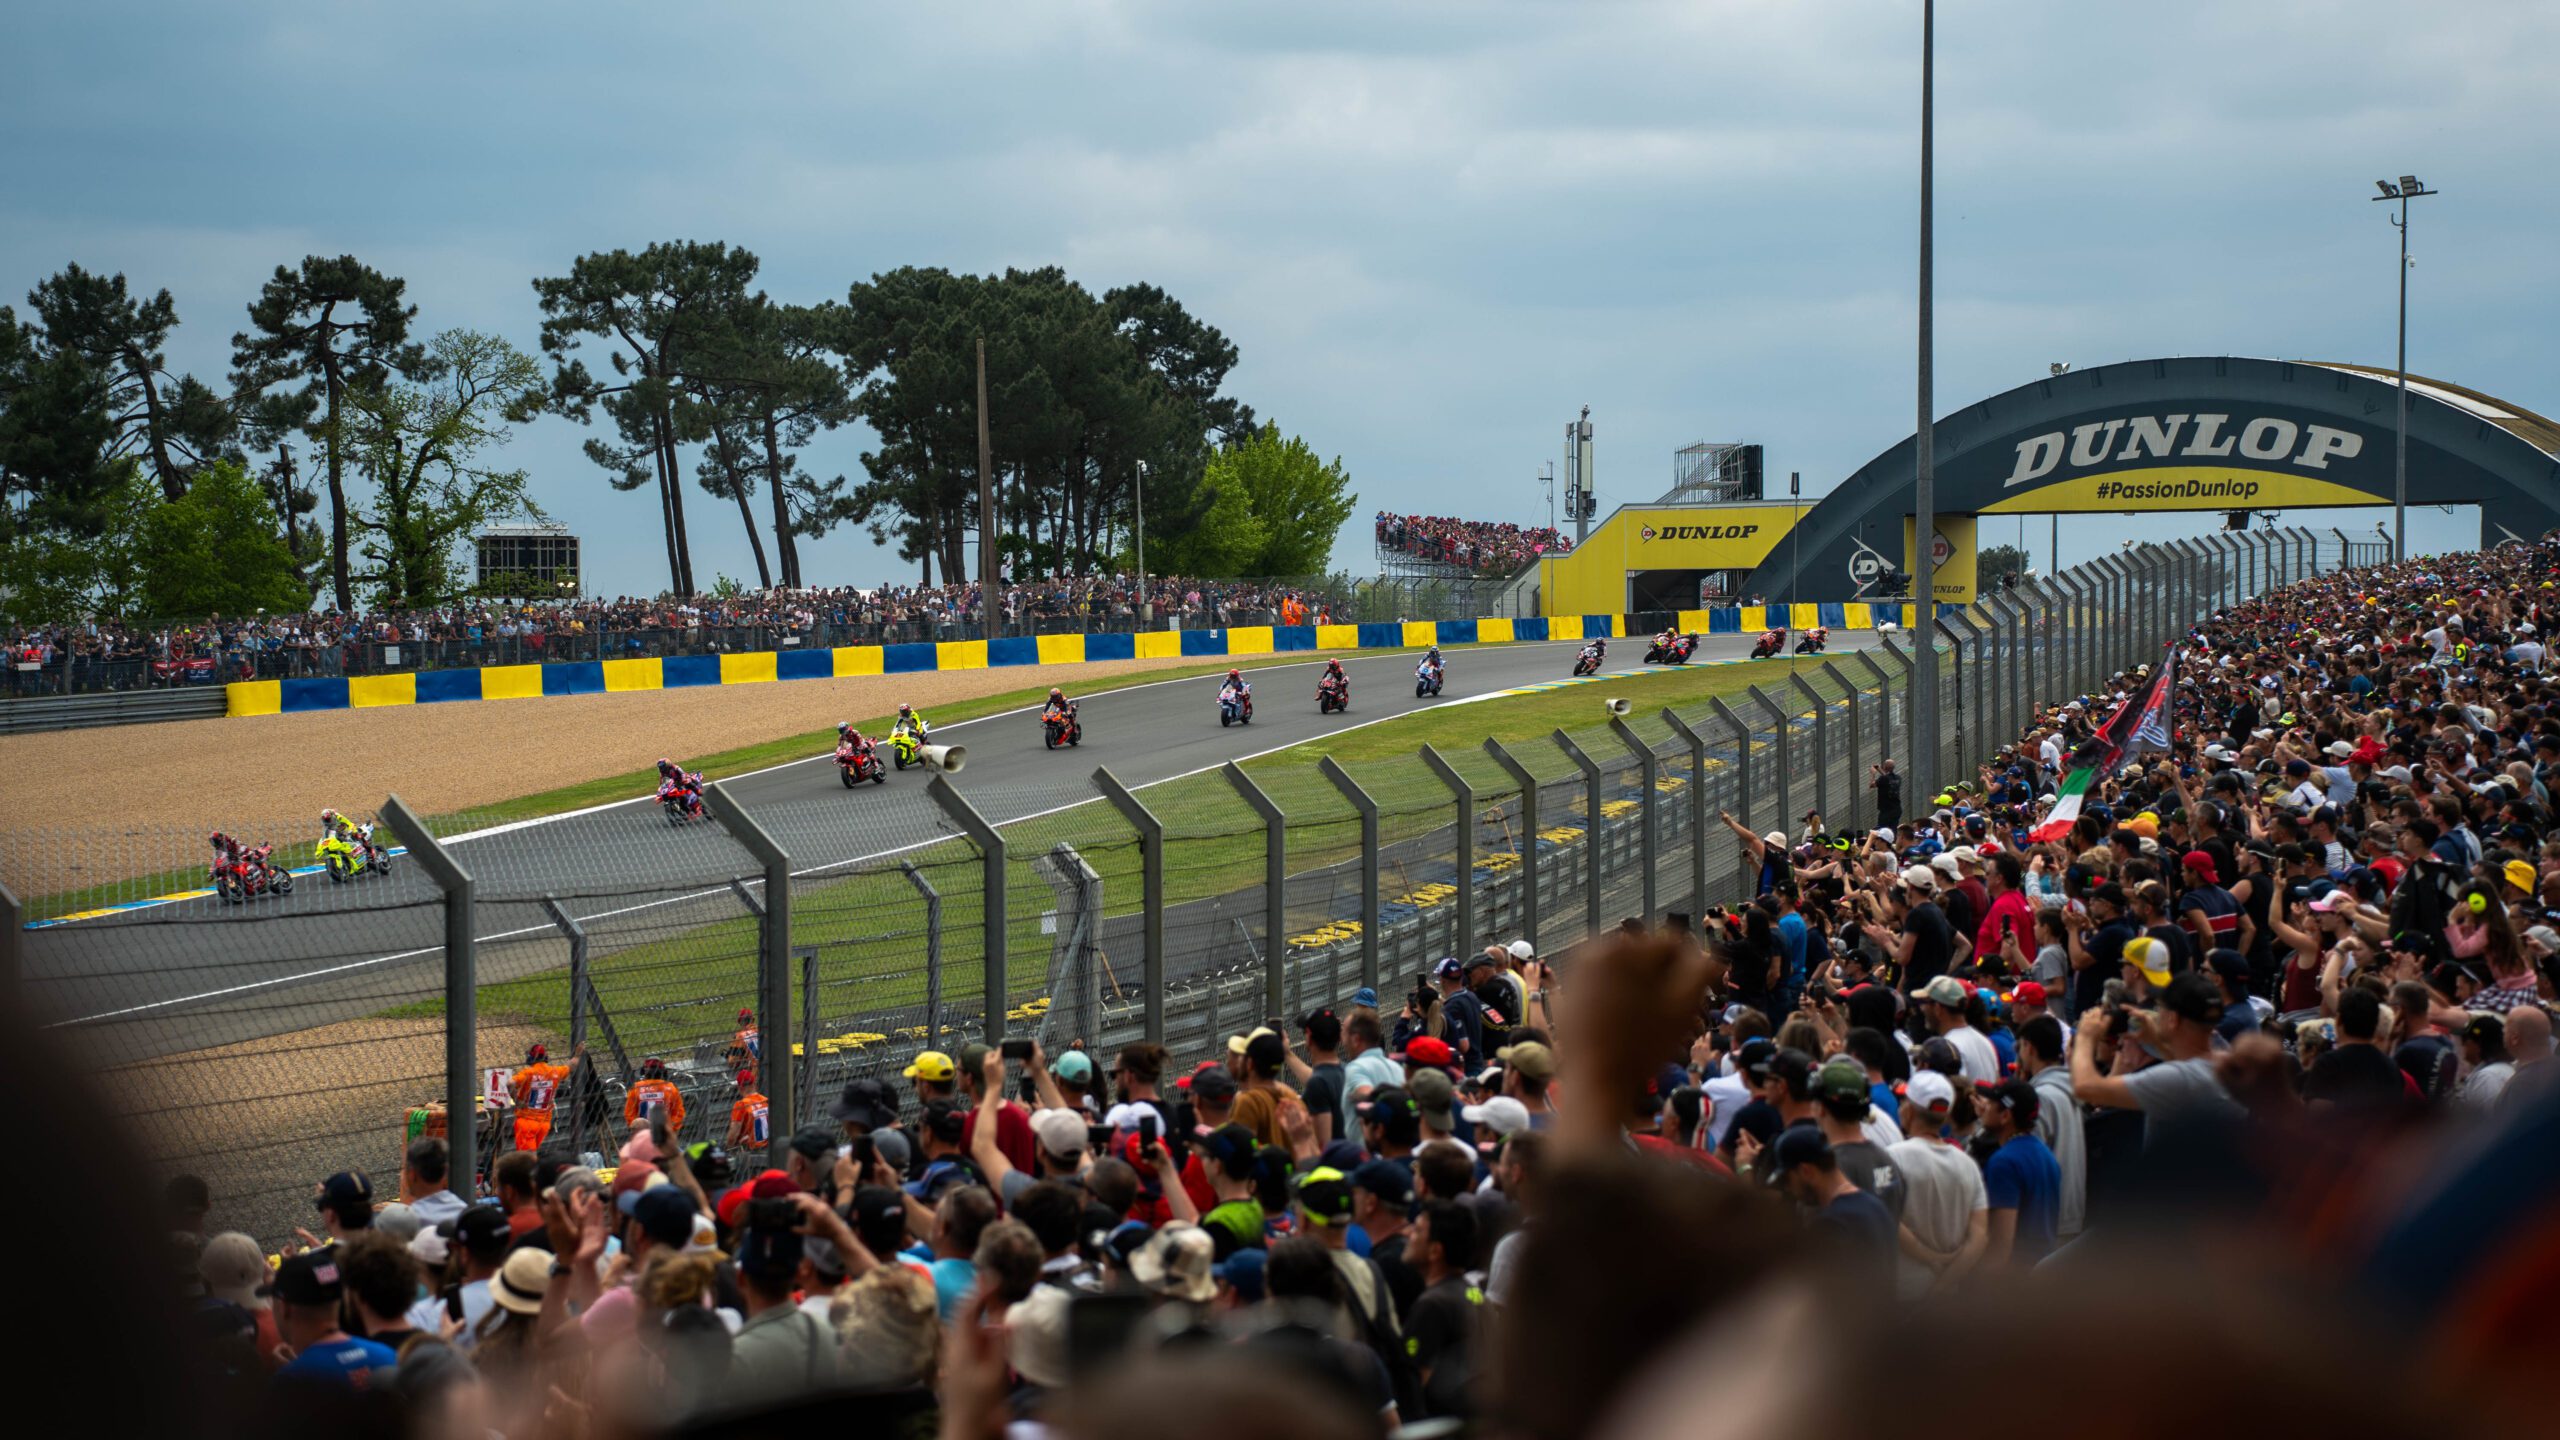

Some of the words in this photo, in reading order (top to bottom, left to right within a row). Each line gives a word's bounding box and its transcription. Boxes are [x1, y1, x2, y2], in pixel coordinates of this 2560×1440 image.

[2004, 413, 2363, 487] DUNLOP
[2097, 477, 2259, 500] #PassionDunlop
[1659, 525, 1759, 540] DUNLOP
[1855, 559, 1879, 575] D
[1933, 585, 1966, 594] UNLOP
